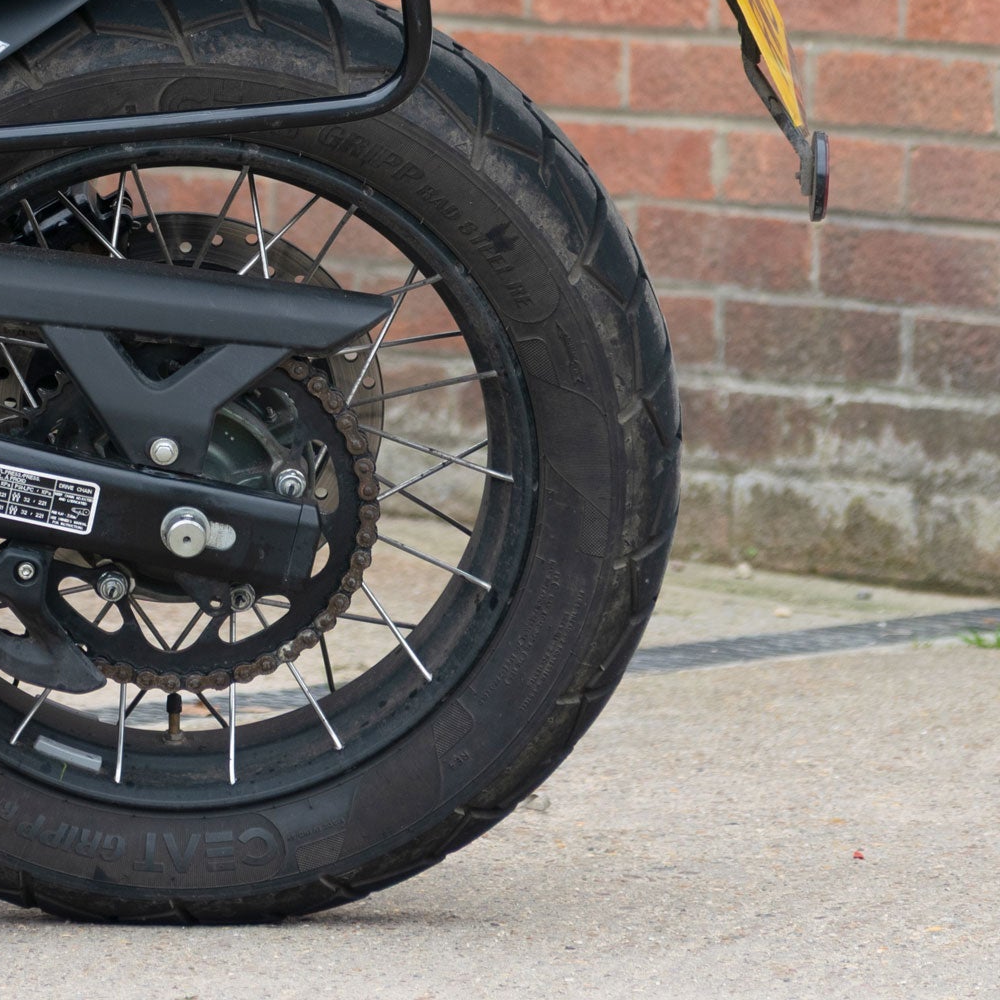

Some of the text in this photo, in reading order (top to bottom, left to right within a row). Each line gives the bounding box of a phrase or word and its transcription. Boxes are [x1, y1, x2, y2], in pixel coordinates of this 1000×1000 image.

[58, 482, 92, 494] DRIVE CHAIN
[15, 814, 127, 862] GRIPP
[133, 826, 279, 874] CEAT
